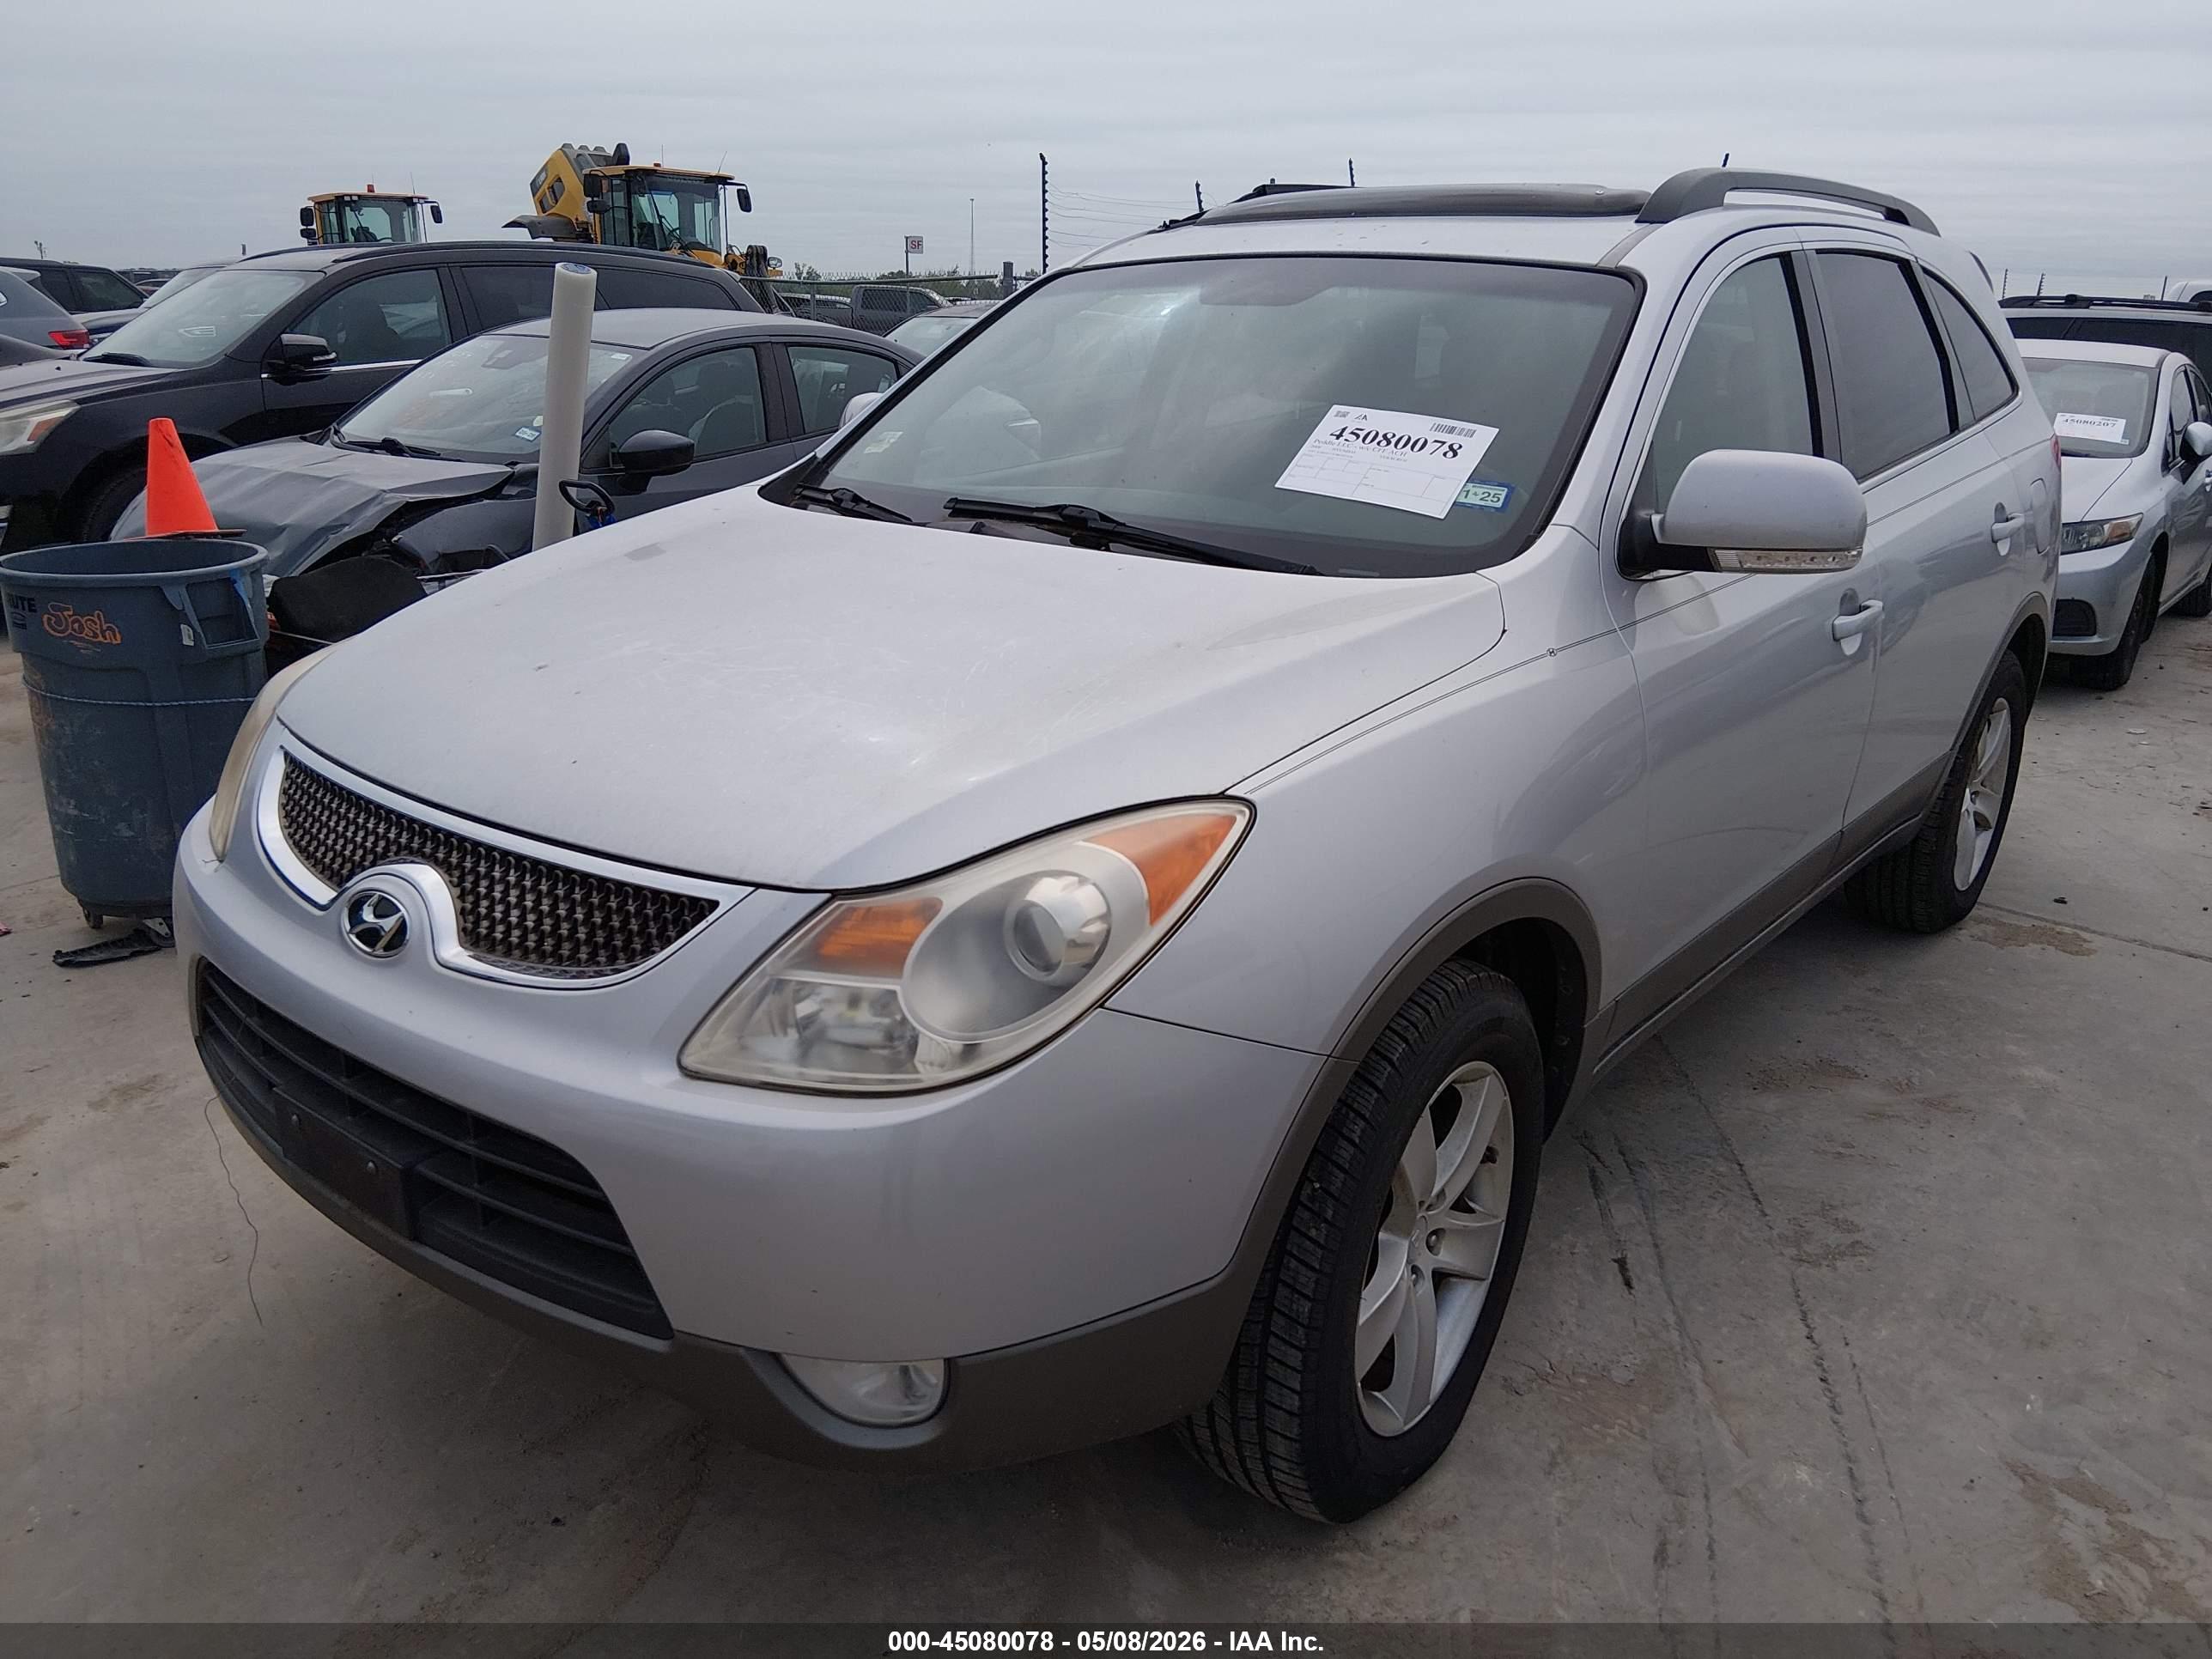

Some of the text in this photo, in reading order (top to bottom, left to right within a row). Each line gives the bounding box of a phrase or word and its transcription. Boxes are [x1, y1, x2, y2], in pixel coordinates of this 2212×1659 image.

[910, 240, 922, 250] SF
[1329, 425, 1463, 460] 45080078
[43, 603, 122, 645] Josh
